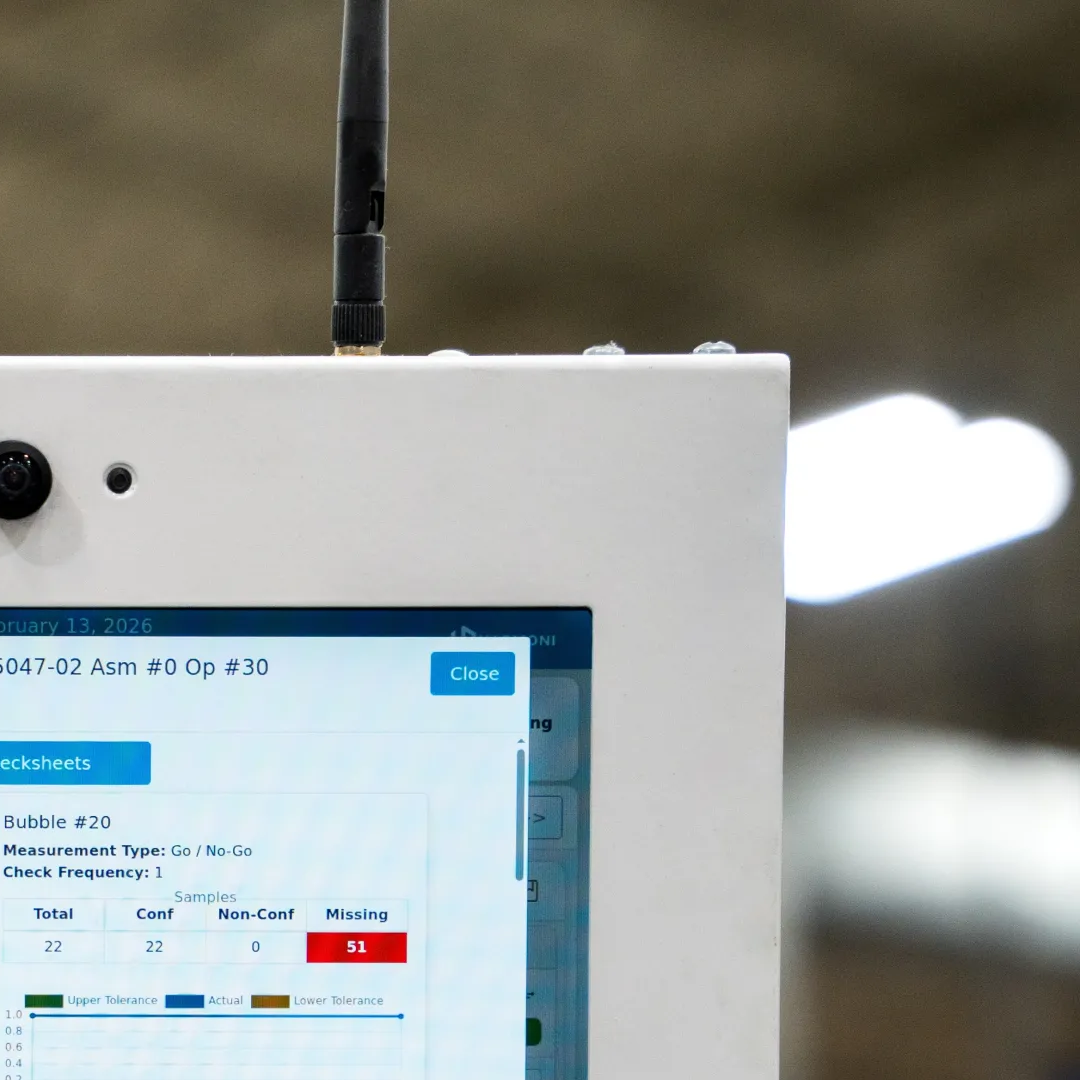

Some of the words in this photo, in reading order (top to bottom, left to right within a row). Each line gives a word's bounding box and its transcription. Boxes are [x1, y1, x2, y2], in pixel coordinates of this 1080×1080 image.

[67, 618, 96, 636] 13,
[104, 618, 153, 634] 2026
[90, 657, 137, 676] Asm
[146, 657, 177, 676] #0
[185, 658, 216, 681] Op
[224, 658, 269, 676] #30
[450, 665, 500, 681] Close
[4, 814, 67, 829] Bubble
[74, 815, 111, 830] #20
[3, 844, 117, 857] Measurement
[121, 844, 166, 860] Type:
[171, 844, 191, 857] Go
[195, 844, 202, 858] /
[206, 844, 253, 857] No-Go
[3, 865, 53, 878] Check
[58, 866, 149, 881] Frequency:
[155, 866, 163, 879] 1
[174, 890, 237, 906] Samples
[33, 907, 73, 920] Total
[136, 907, 175, 920] Conf
[218, 908, 295, 920] Non-Conf
[326, 908, 388, 923] Missing
[44, 940, 62, 953] 22
[145, 940, 163, 953] 22
[251, 940, 261, 953] 0
[346, 940, 367, 953] 51
[67, 995, 101, 1007] Upper
[104, 994, 158, 1005] Tolerance
[208, 995, 243, 1005] Actual
[294, 995, 327, 1006] Lower
[330, 995, 384, 1006] Tolerance
[5, 1009, 23, 1020] 1.0
[5, 1026, 23, 1036] 0.8
[5, 1042, 23, 1052] 0.6
[5, 1058, 23, 1068] 0.4
